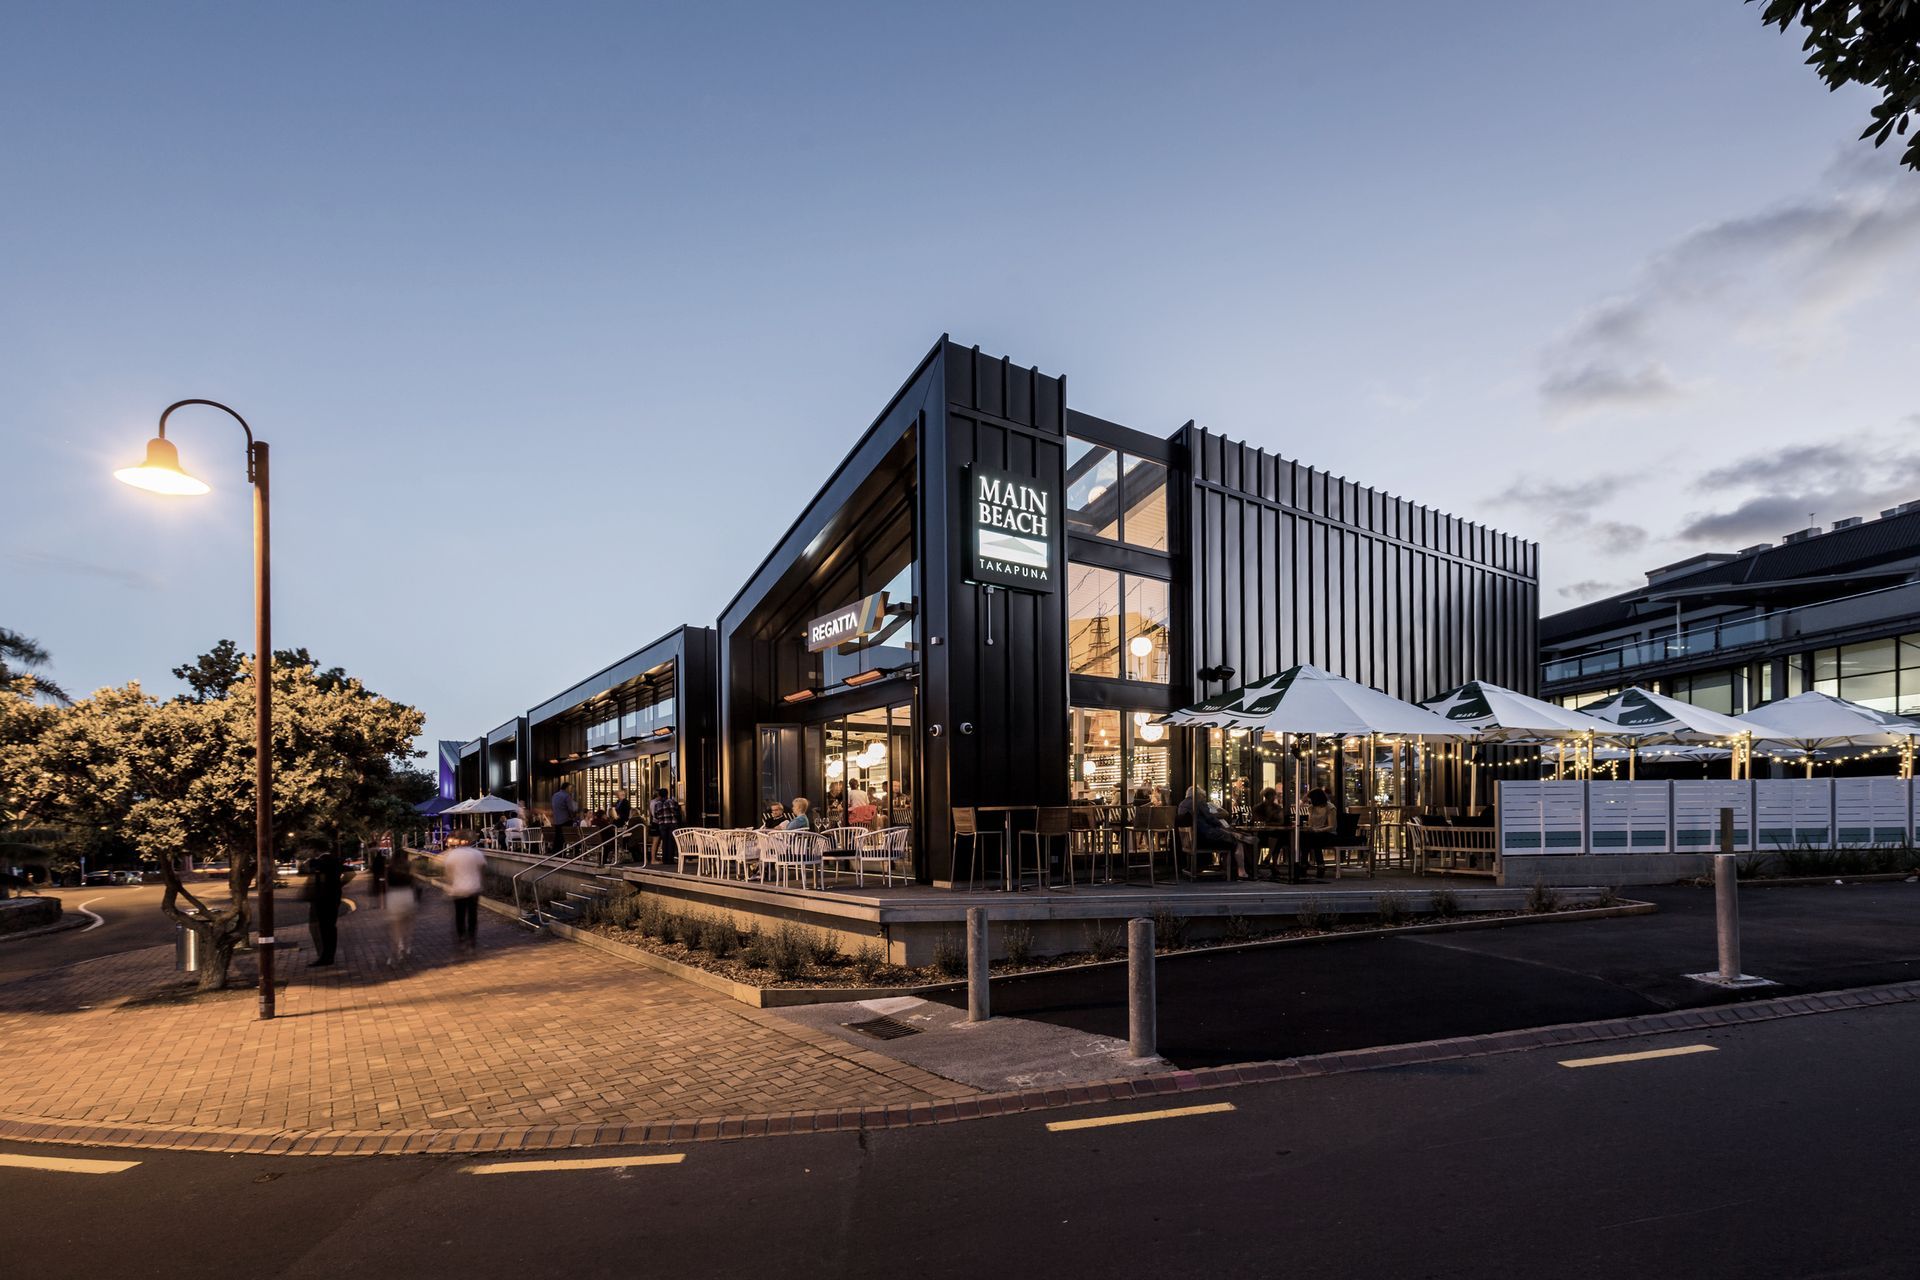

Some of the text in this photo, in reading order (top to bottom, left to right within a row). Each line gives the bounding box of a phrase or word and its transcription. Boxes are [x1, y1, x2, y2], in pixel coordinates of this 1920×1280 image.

[979, 476, 1048, 515] MAIN
[979, 502, 1048, 537] BEACH
[979, 558, 1048, 580] TAKAPUNA
[812, 612, 858, 643] REGATTA
